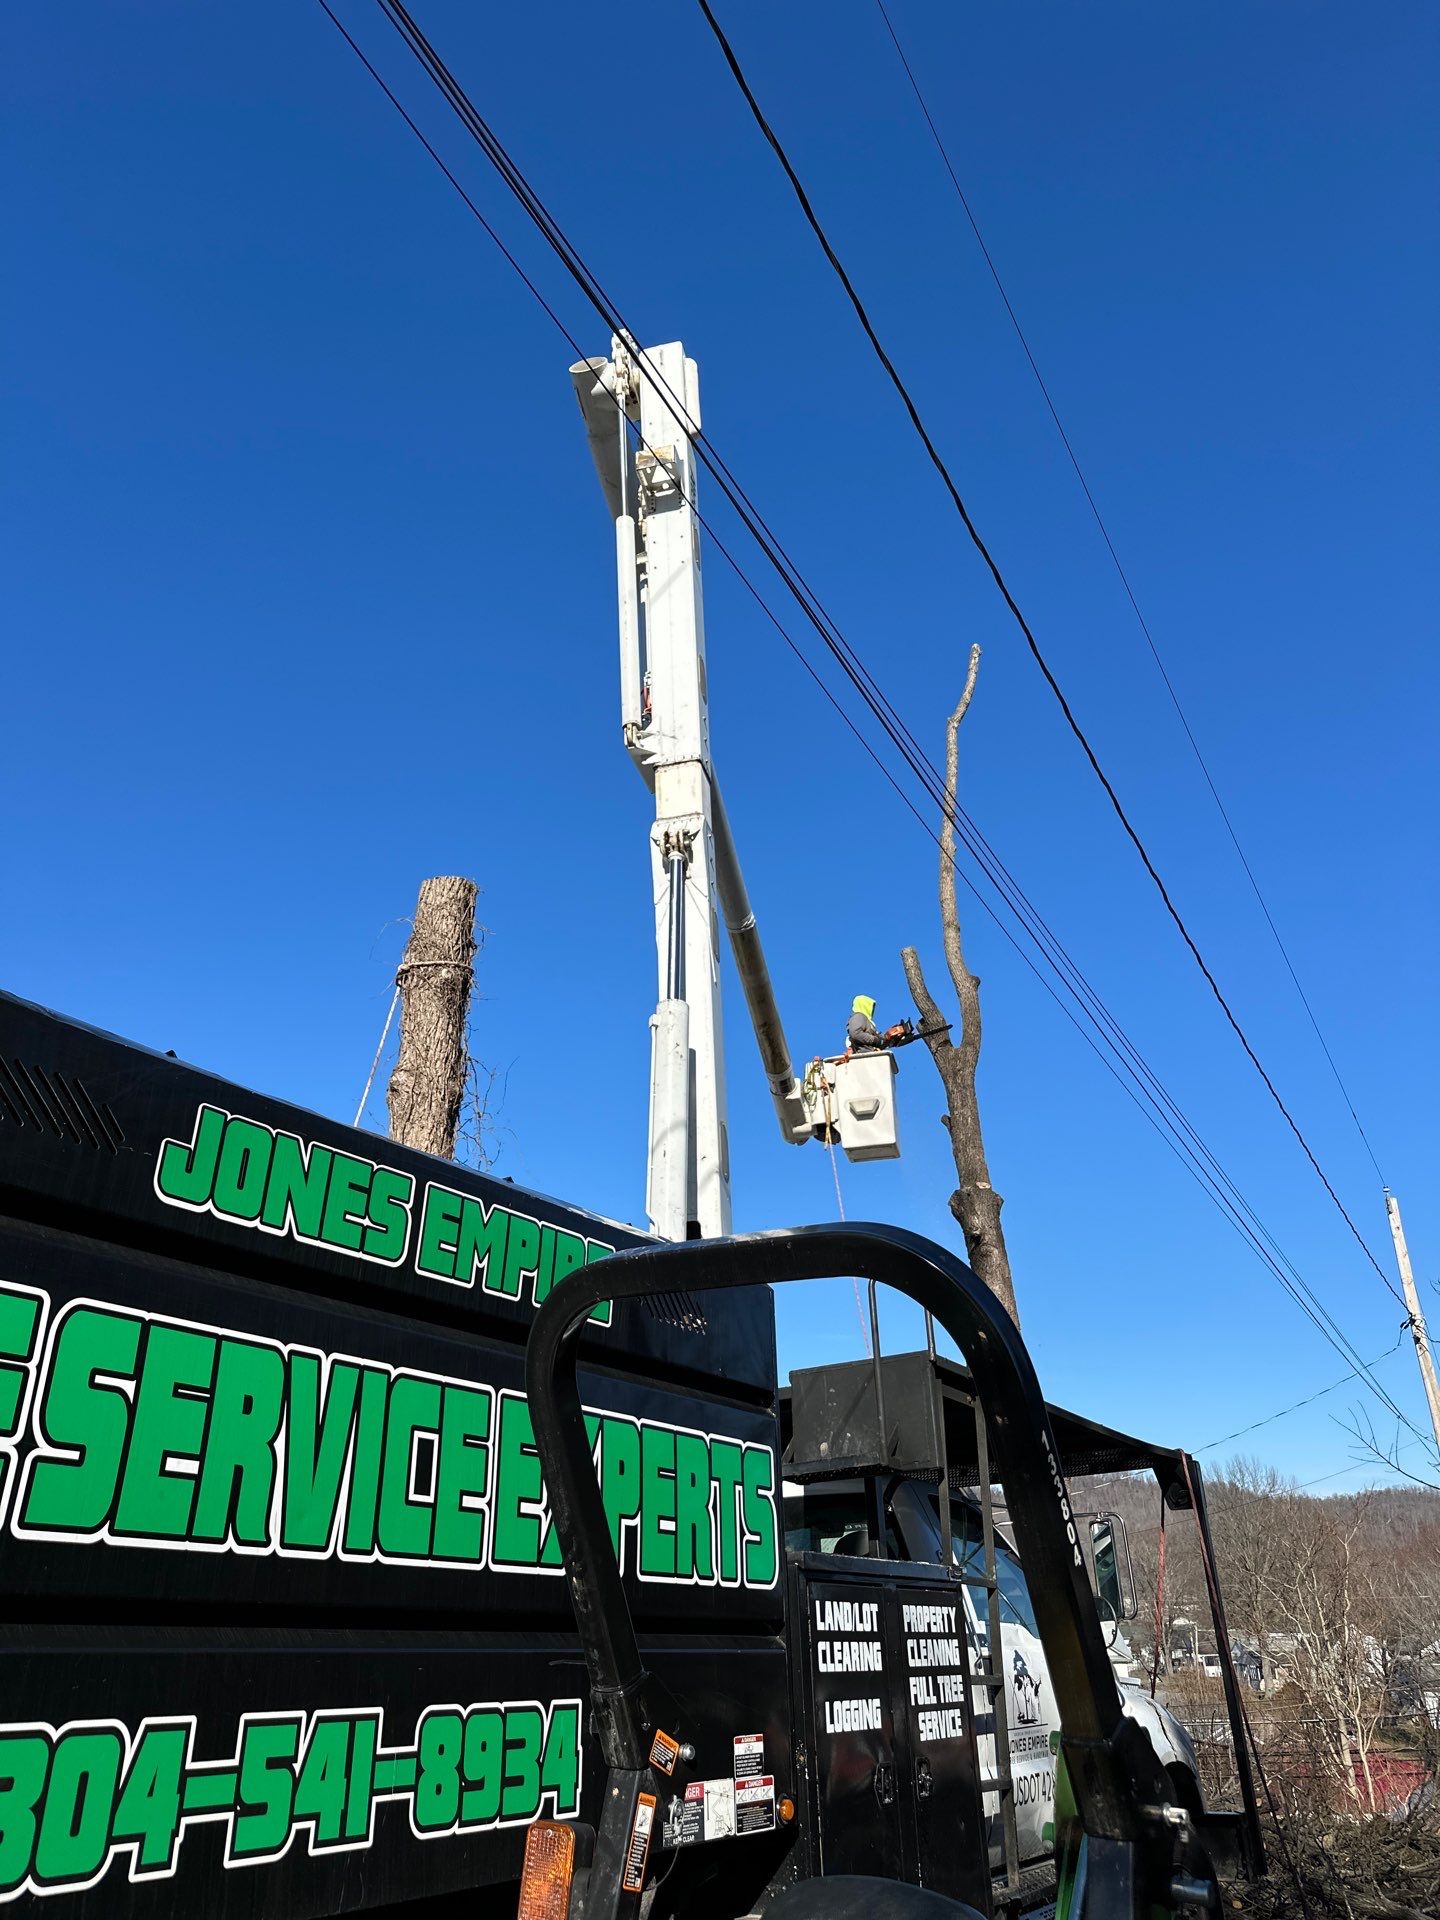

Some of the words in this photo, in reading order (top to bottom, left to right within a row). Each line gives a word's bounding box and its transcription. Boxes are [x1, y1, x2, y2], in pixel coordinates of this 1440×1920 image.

[155, 1103, 414, 1267] JONES
[11, 1297, 493, 1570] SERVICE
[491, 1388, 780, 1590] EPERTS
[1041, 1430, 1084, 1567] 133804
[815, 1600, 879, 1632] LAND/LOT
[902, 1605, 956, 1633] PROPERTY
[817, 1641, 883, 1673] CLEARING
[906, 1639, 961, 1667] CLEANING
[909, 1676, 937, 1706] FULL
[937, 1674, 965, 1703] TREE
[825, 1698, 882, 1734] LOGGING
[918, 1708, 963, 1742] SERVICE
[1010, 1738, 1027, 1754] ONES
[1028, 1734, 1048, 1751] EMPIRE
[1013, 1773, 1040, 1807] USDOT
